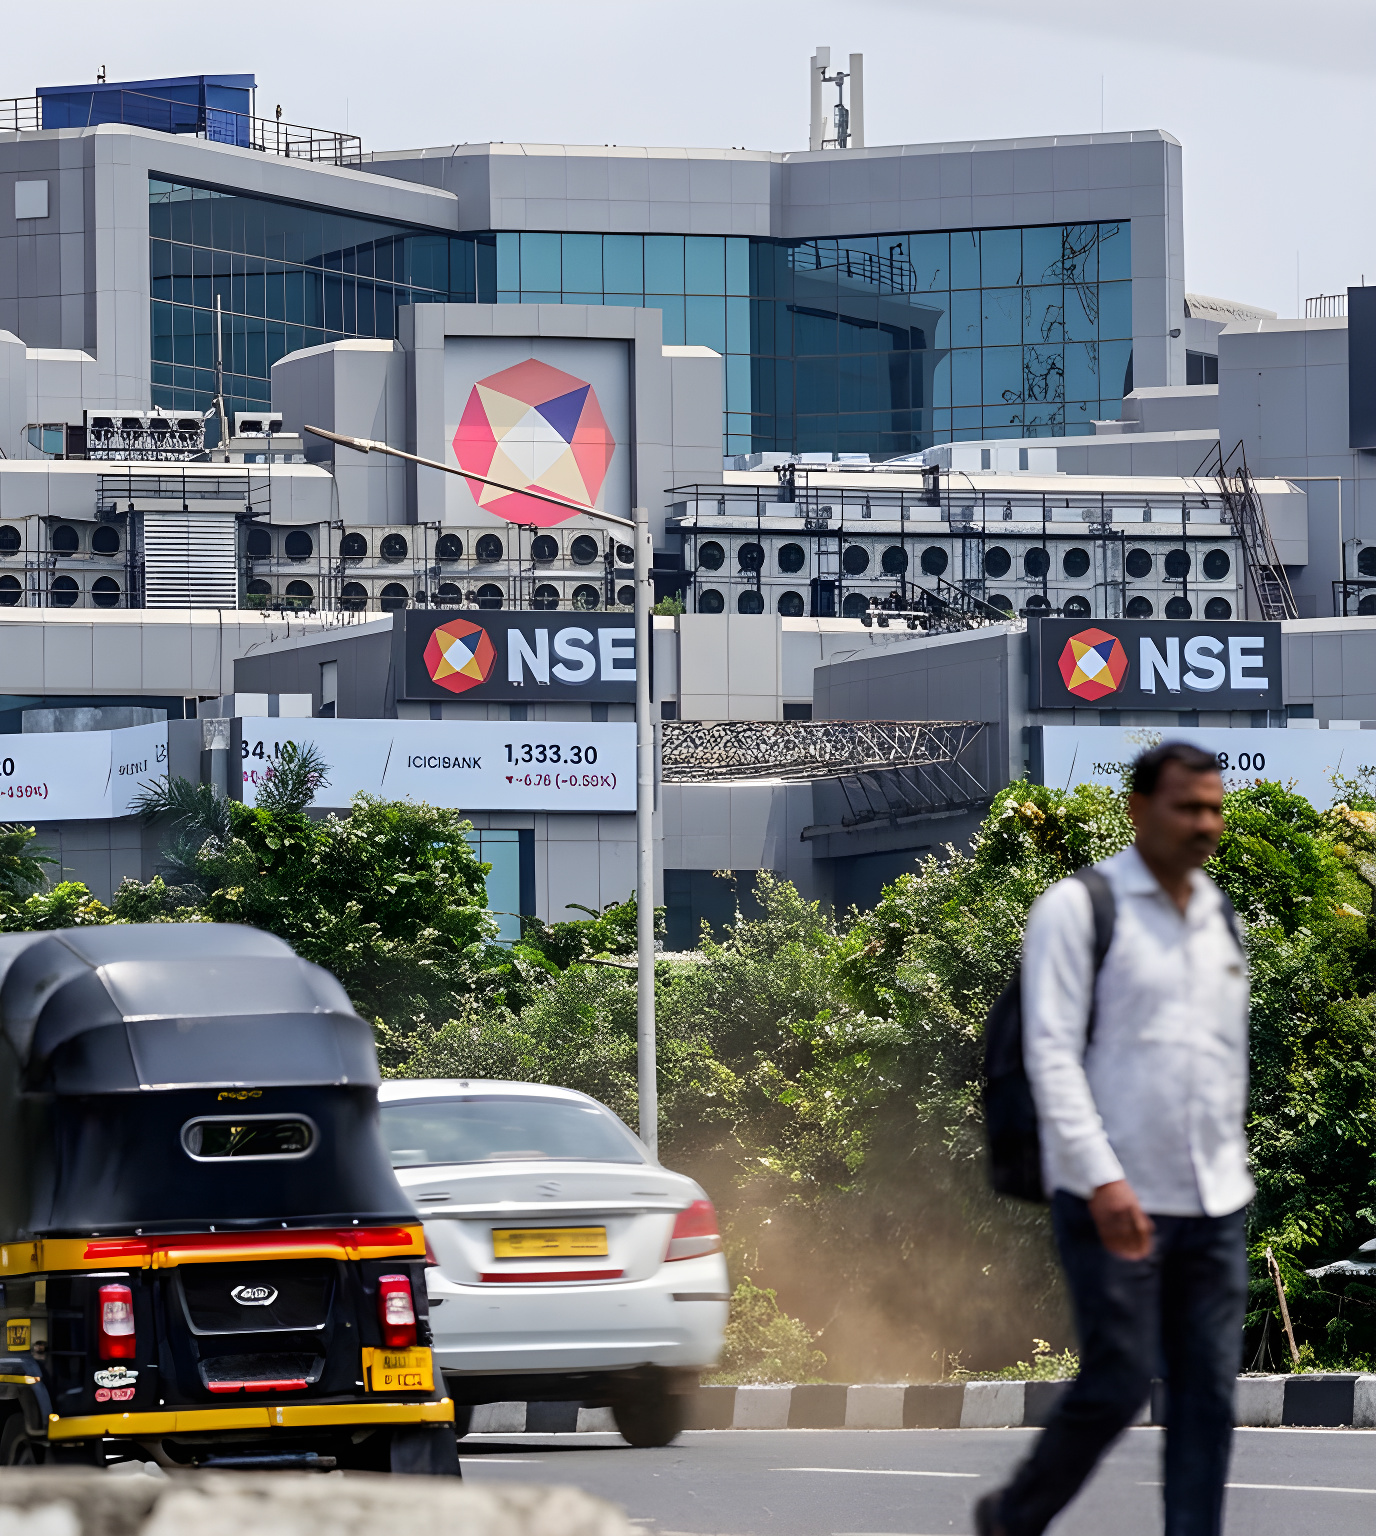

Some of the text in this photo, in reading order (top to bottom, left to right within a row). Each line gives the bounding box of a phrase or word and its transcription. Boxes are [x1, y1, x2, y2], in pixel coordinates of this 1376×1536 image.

[507, 626, 637, 686] NSE
[1139, 635, 1269, 694] NSE
[504, 743, 598, 765] 1,333.30
